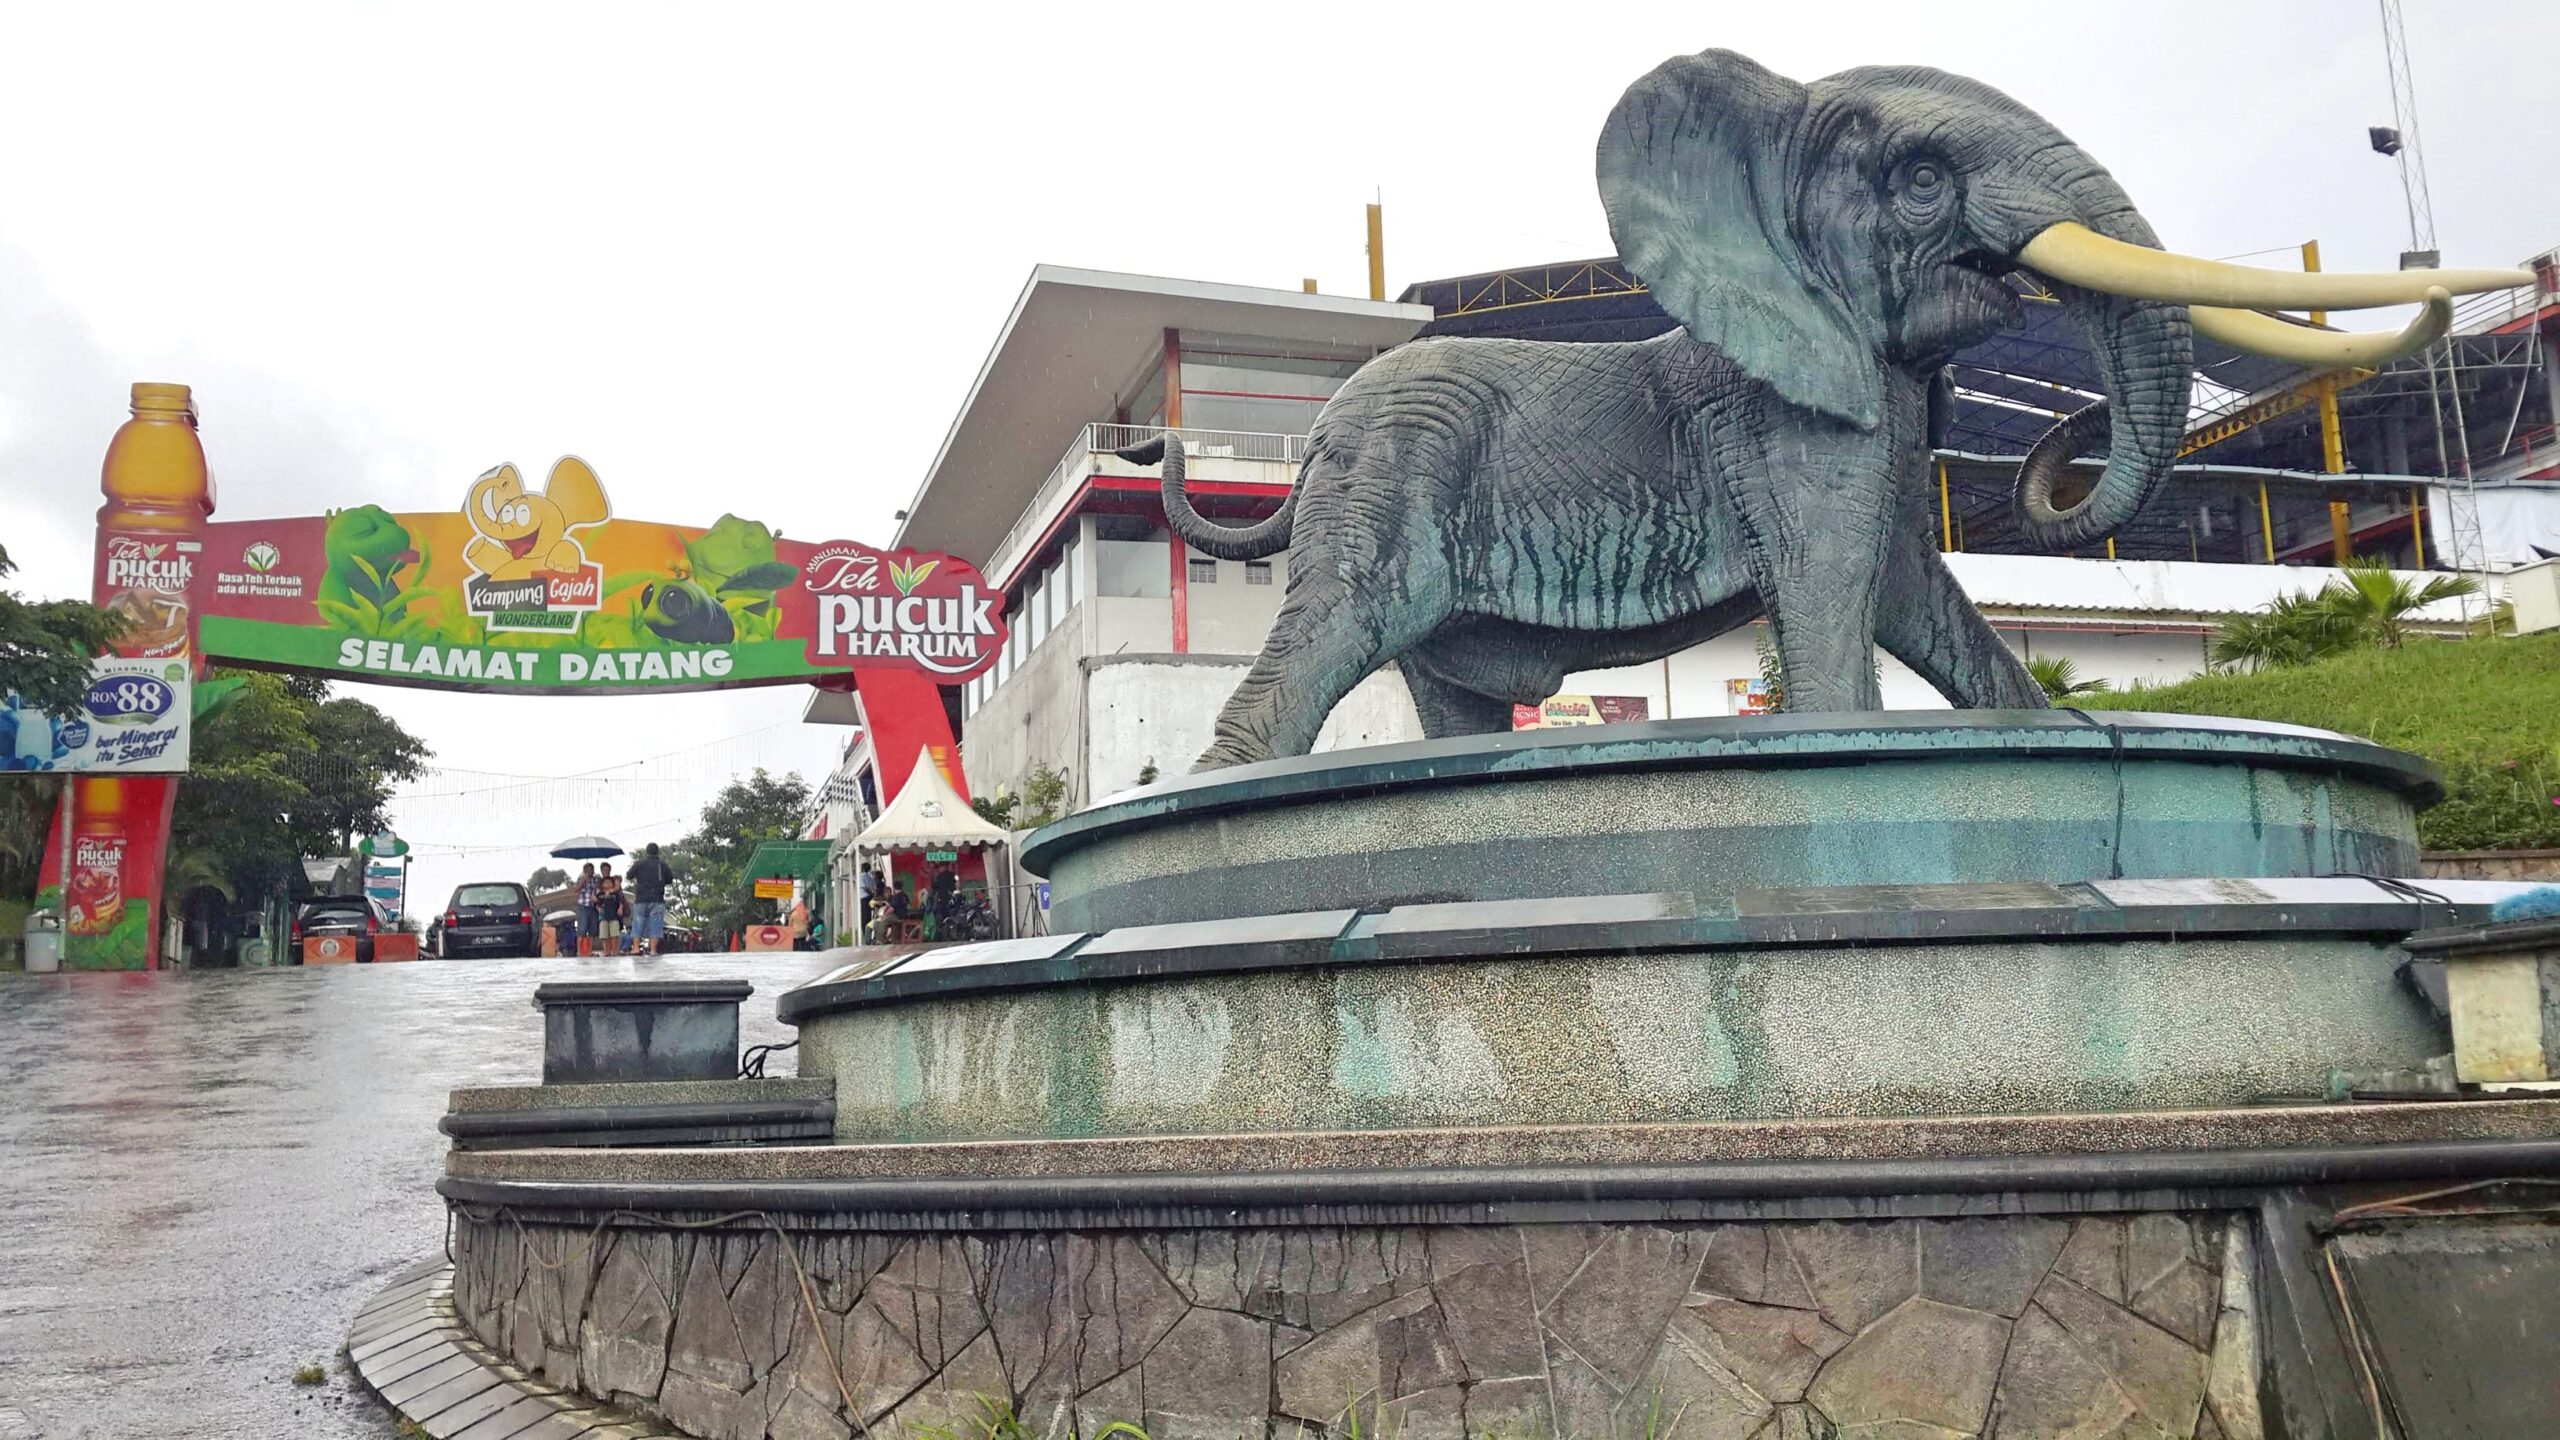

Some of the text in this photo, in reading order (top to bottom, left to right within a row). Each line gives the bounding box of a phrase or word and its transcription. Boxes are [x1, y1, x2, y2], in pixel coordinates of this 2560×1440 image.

[108, 541, 142, 559] Teh
[806, 547, 860, 574] MINUMAN
[107, 555, 193, 586] pucuk
[218, 573, 302, 585] Rasa Teh Terbaik
[805, 555, 880, 591] Teh
[122, 576, 188, 593] HARUM
[217, 585, 302, 597] ada di Pucuknya!
[472, 577, 595, 609] Kampung Gajah
[494, 613, 574, 626] WONDERLAND
[817, 585, 996, 655] pucuk
[337, 638, 734, 681] SELAMAT DATANG
[848, 632, 984, 668] HARUM
[104, 665, 155, 674] Minumlah
[95, 742, 169, 763] itu Sehat
[77, 846, 122, 866] pucuk
